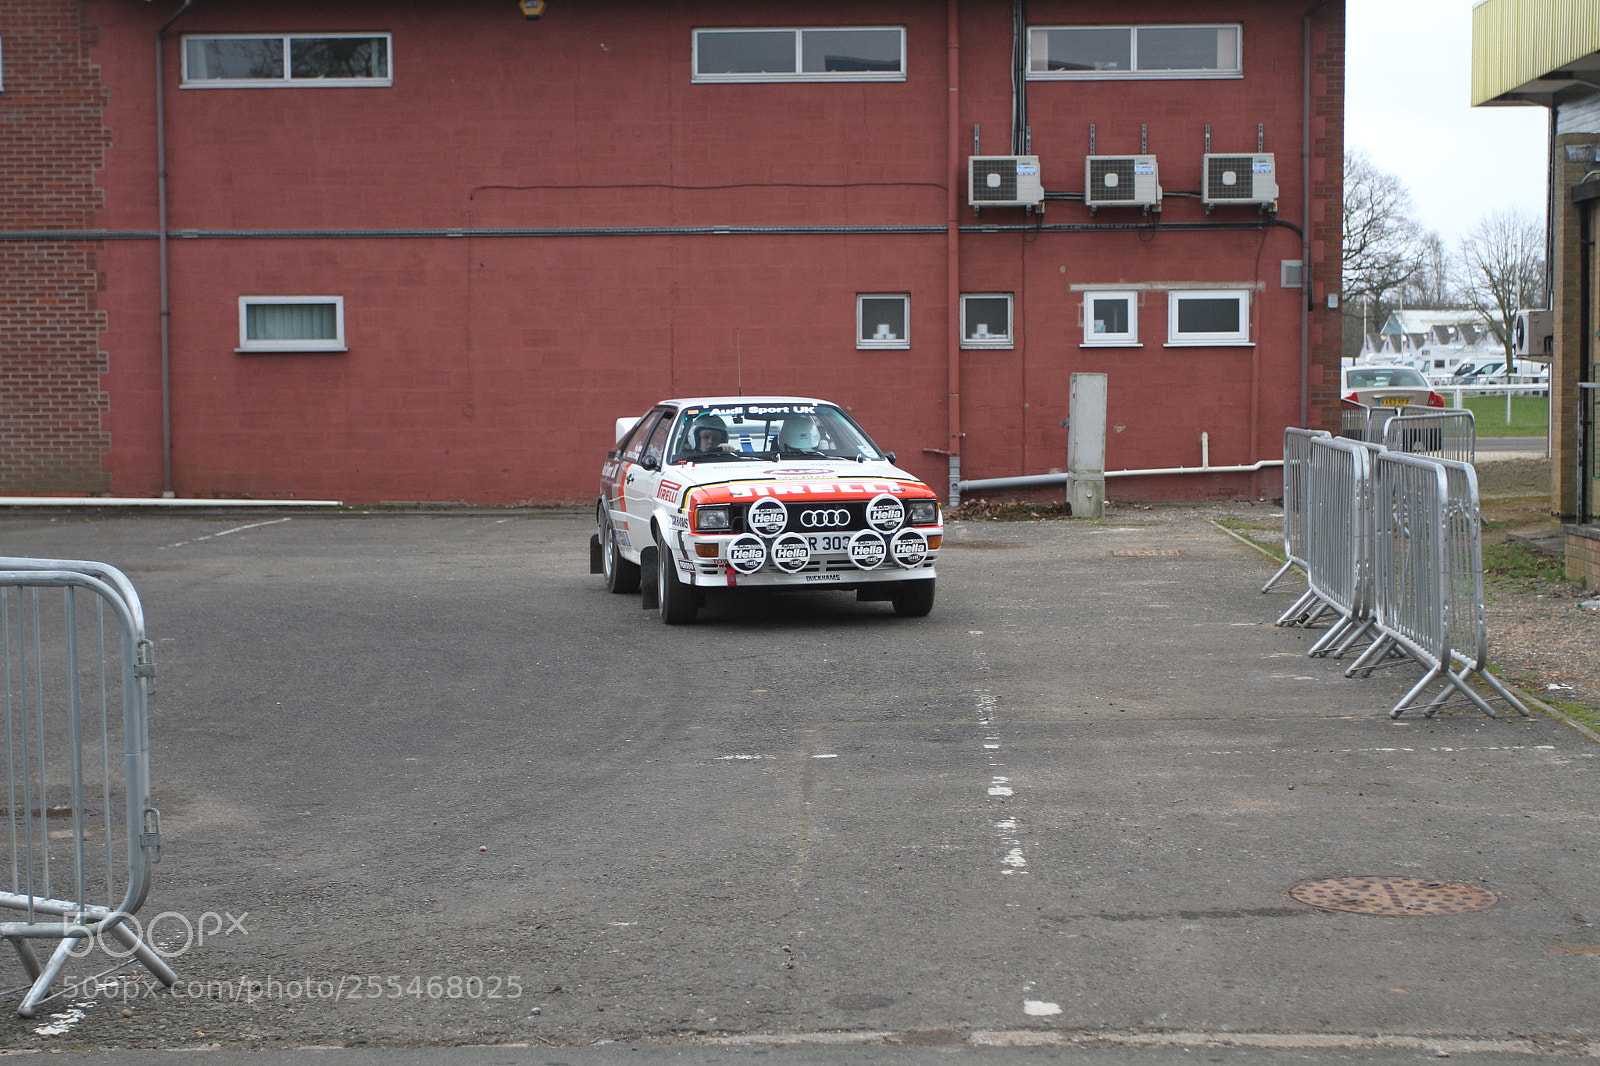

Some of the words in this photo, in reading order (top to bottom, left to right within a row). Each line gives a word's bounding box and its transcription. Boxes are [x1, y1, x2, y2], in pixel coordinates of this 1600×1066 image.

[709, 407, 743, 416] Audi
[748, 406, 789, 415] Sport
[793, 406, 815, 414] UK
[656, 479, 682, 504] PIRELLI
[727, 481, 903, 498] PIRELLI
[754, 513, 784, 523] Hella
[872, 510, 901, 520] Hella
[822, 535, 851, 551] 303
[733, 548, 763, 559] Hella
[777, 548, 807, 558] Hella
[854, 545, 883, 555] Hella
[896, 544, 925, 553] Hella
